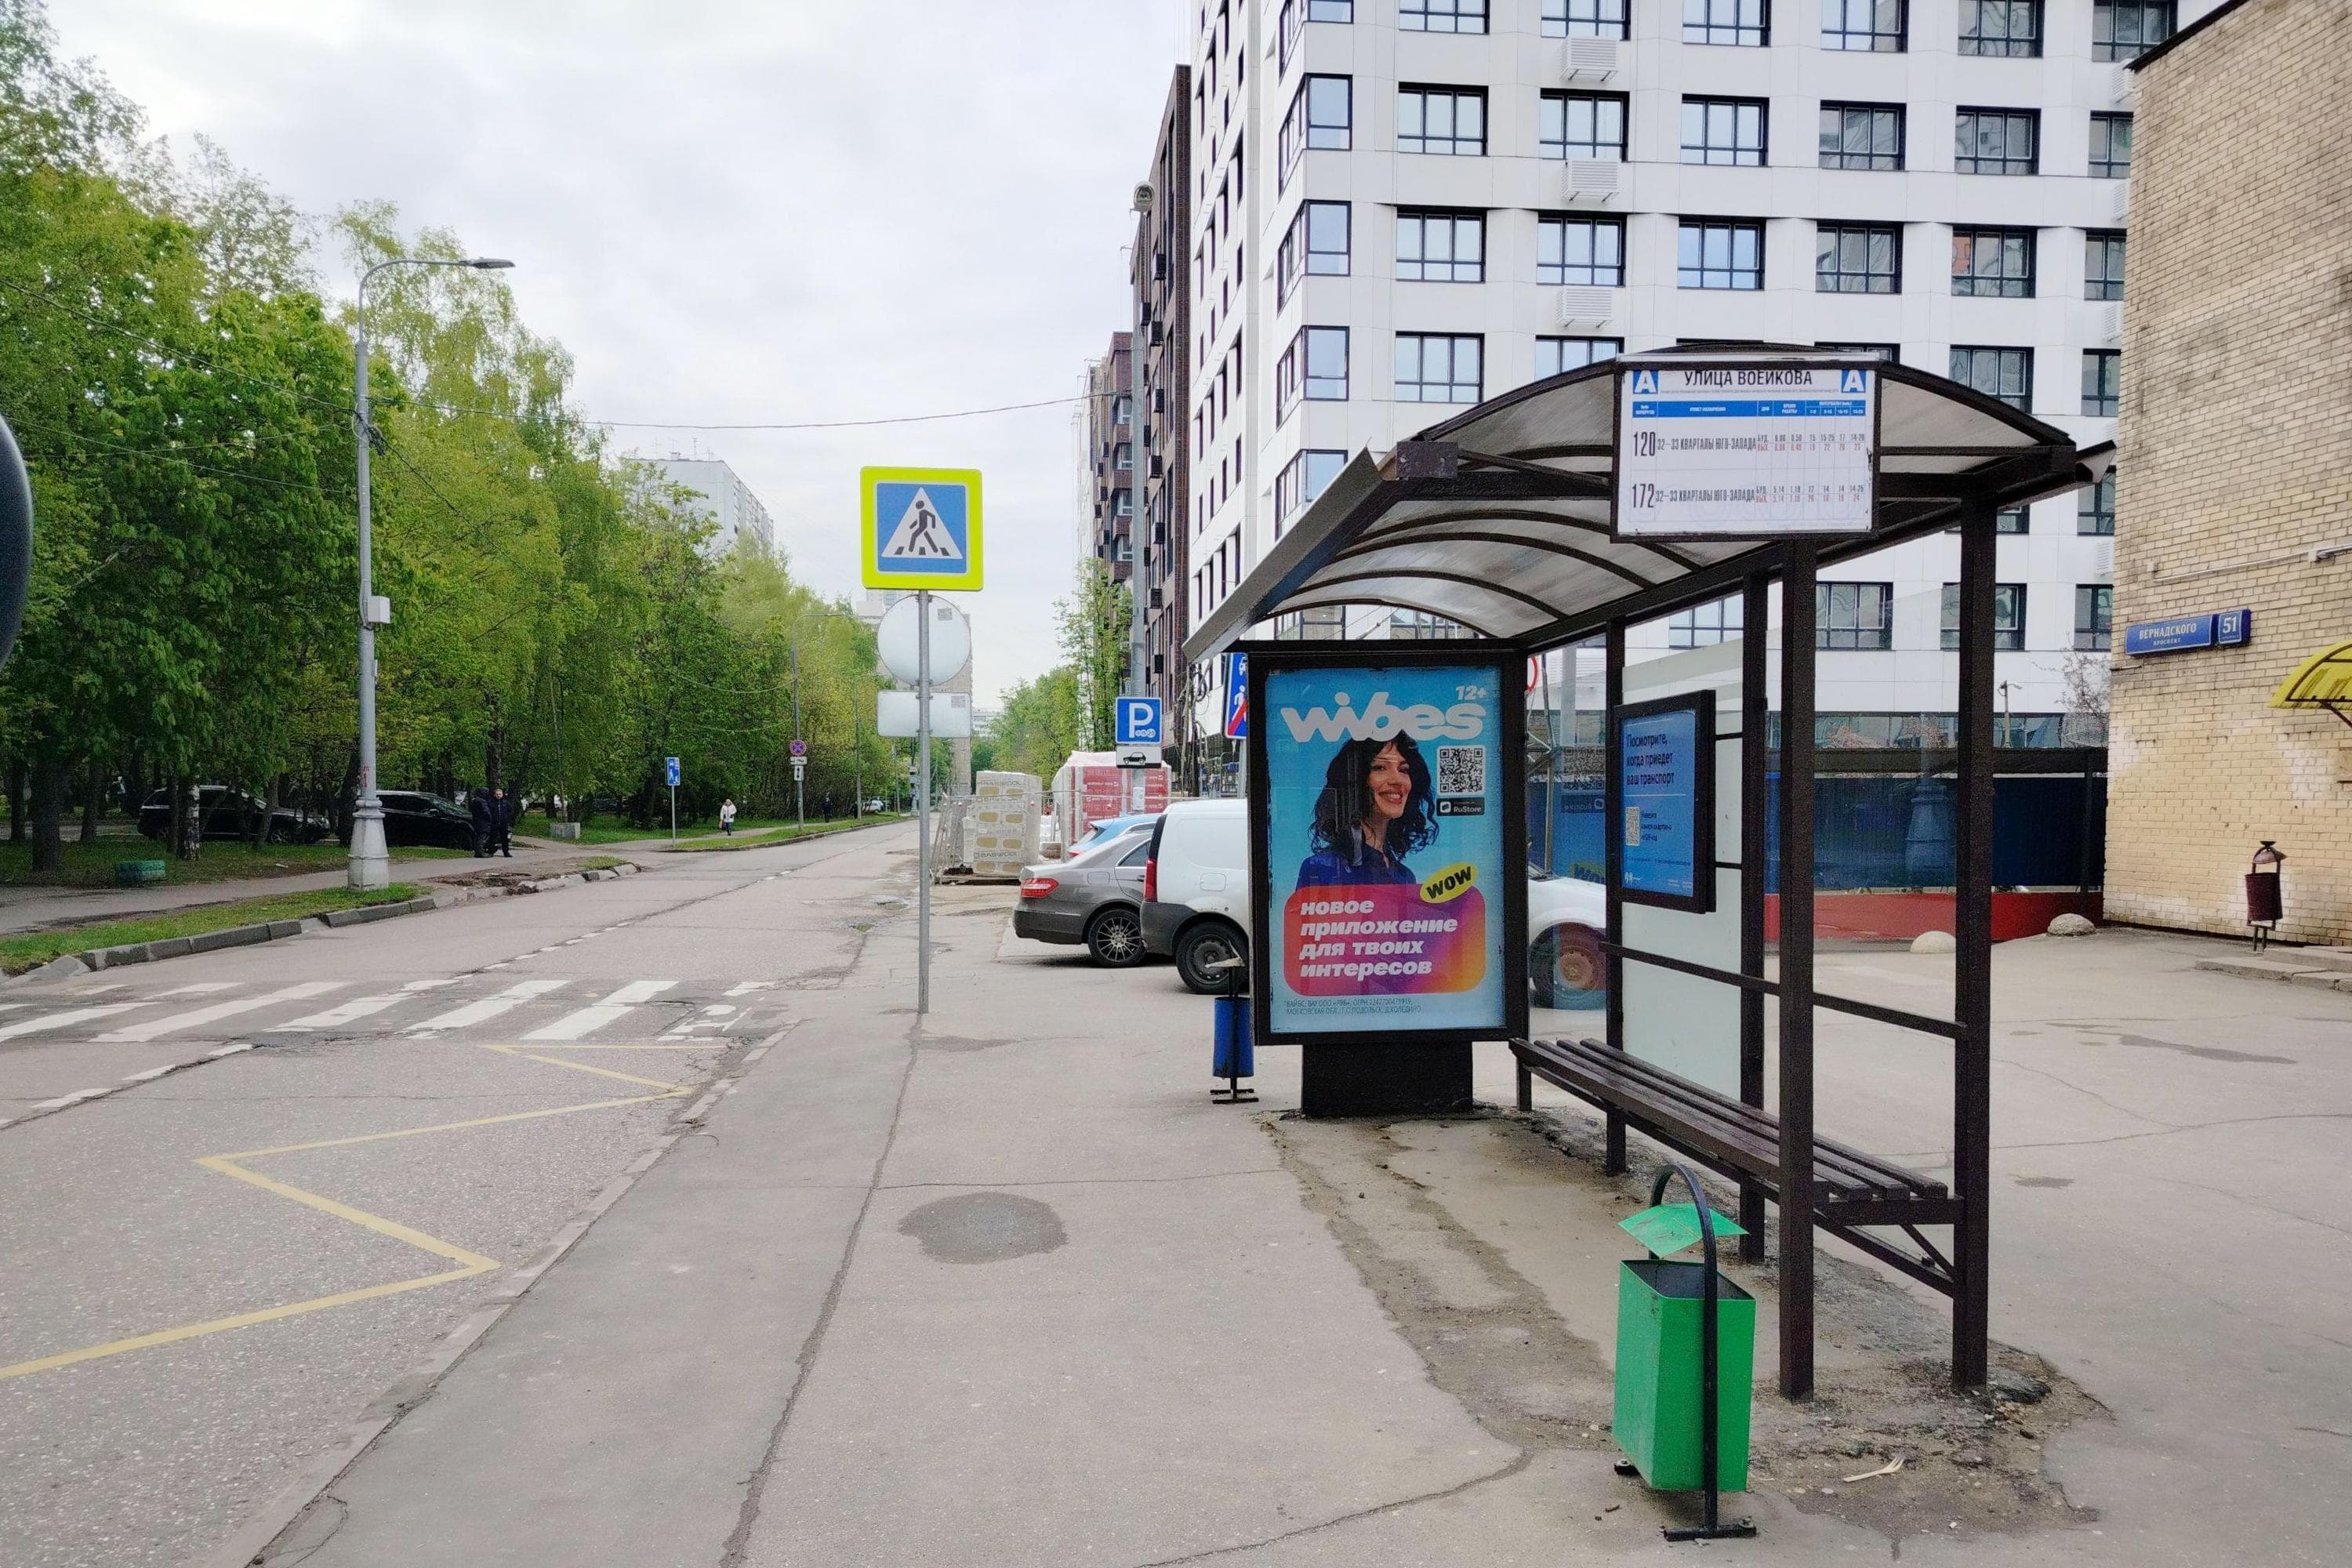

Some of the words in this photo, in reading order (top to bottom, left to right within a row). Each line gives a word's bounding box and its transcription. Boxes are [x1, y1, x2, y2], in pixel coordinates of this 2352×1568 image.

[1684, 371, 1733, 387] УЛИЦА
[1633, 431, 1656, 457] 120
[1680, 437, 1714, 451] КВАРТАЛЫ
[1715, 437, 1756, 452] ЮГО-ЗАПАДА
[1632, 483, 1655, 508] 172
[1679, 489, 1712, 502] КВАРТАЛЫ
[1714, 489, 1755, 503] ЮГО-ЗАПАДА
[2139, 622, 2197, 640] ВЕРНАДСКОГО
[2222, 616, 2238, 633] 51
[1455, 684, 1487, 700] 12+
[1129, 702, 1153, 738] P
[1627, 734, 1668, 748] Посмотрите,
[1627, 755, 1644, 768] когда
[1645, 753, 1673, 768] приедет
[1627, 775, 1639, 786] ваш
[1640, 772, 1675, 788] транспорт
[1454, 804, 1482, 813] RuStore
[1300, 899, 1374, 916] новое
[1300, 917, 1458, 942] приложение
[1299, 942, 1345, 961] для
[1352, 940, 1425, 956] твоих
[1300, 960, 1432, 982] интересов
